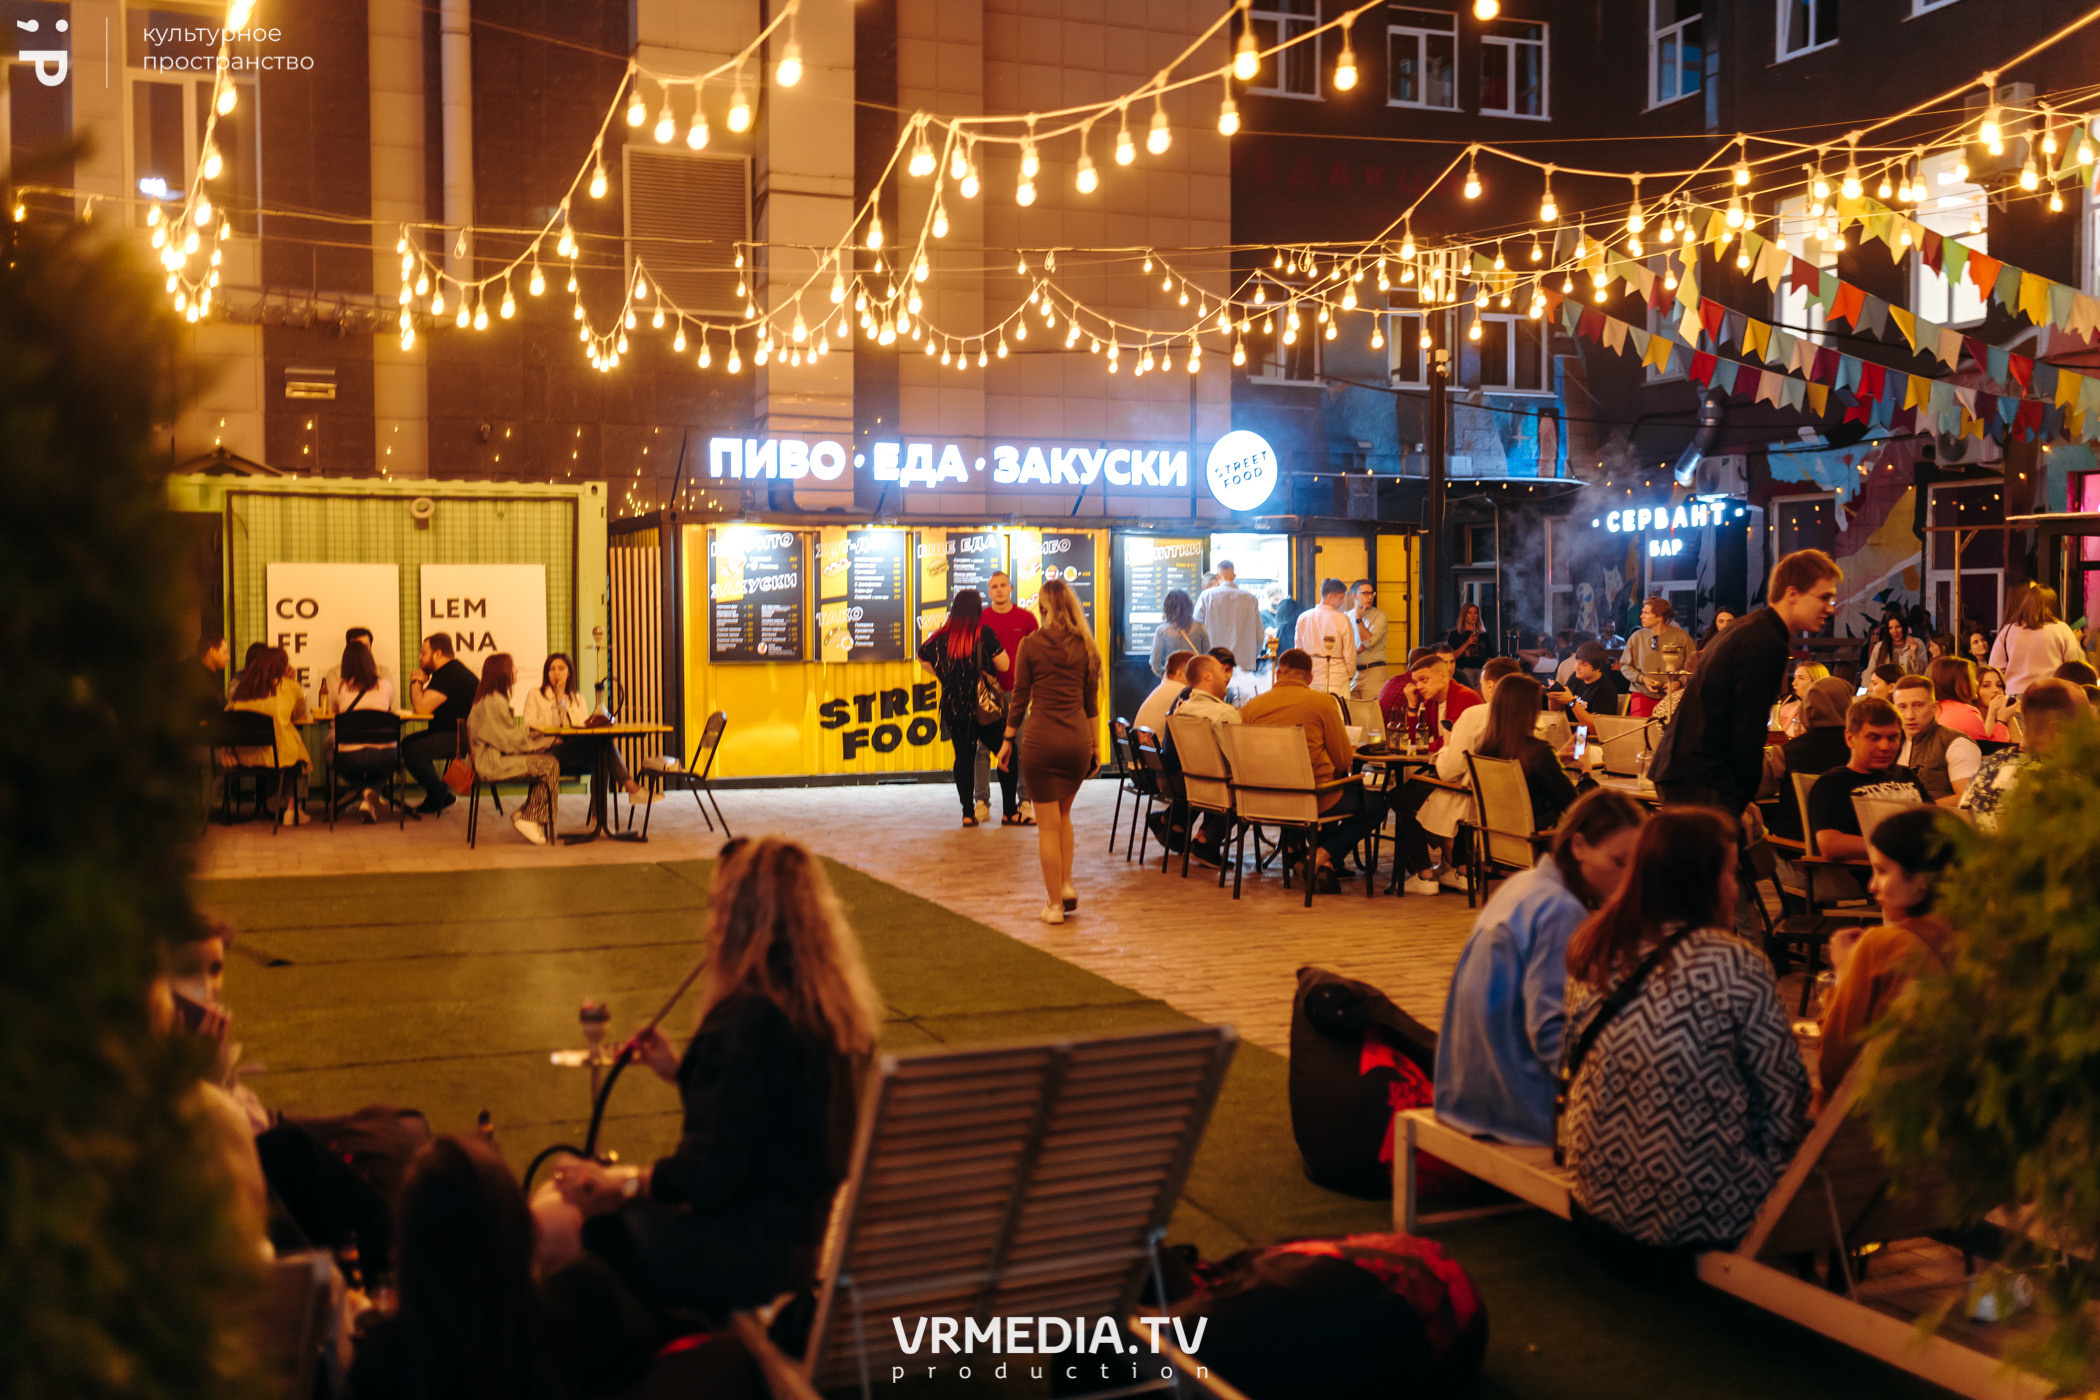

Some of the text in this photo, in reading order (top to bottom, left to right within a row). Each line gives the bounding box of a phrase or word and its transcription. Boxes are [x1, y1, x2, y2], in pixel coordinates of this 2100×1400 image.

[709, 437, 1188, 488] ПИВО ЕДА ЗАКУСКИ
[1214, 450, 1267, 479] STREET
[1223, 467, 1263, 489] FOOD
[1606, 501, 1726, 533] СЕРВАНТ
[961, 533, 998, 554] ЕДА
[1648, 538, 1684, 558] БАР
[710, 572, 798, 600] ЗАКУСКИ
[275, 598, 319, 619] CO
[430, 598, 487, 619] LEM
[815, 606, 864, 628] ТАКО
[916, 610, 951, 631] WO
[277, 632, 308, 654] FF
[452, 631, 498, 652] NA
[819, 680, 938, 730] STRE
